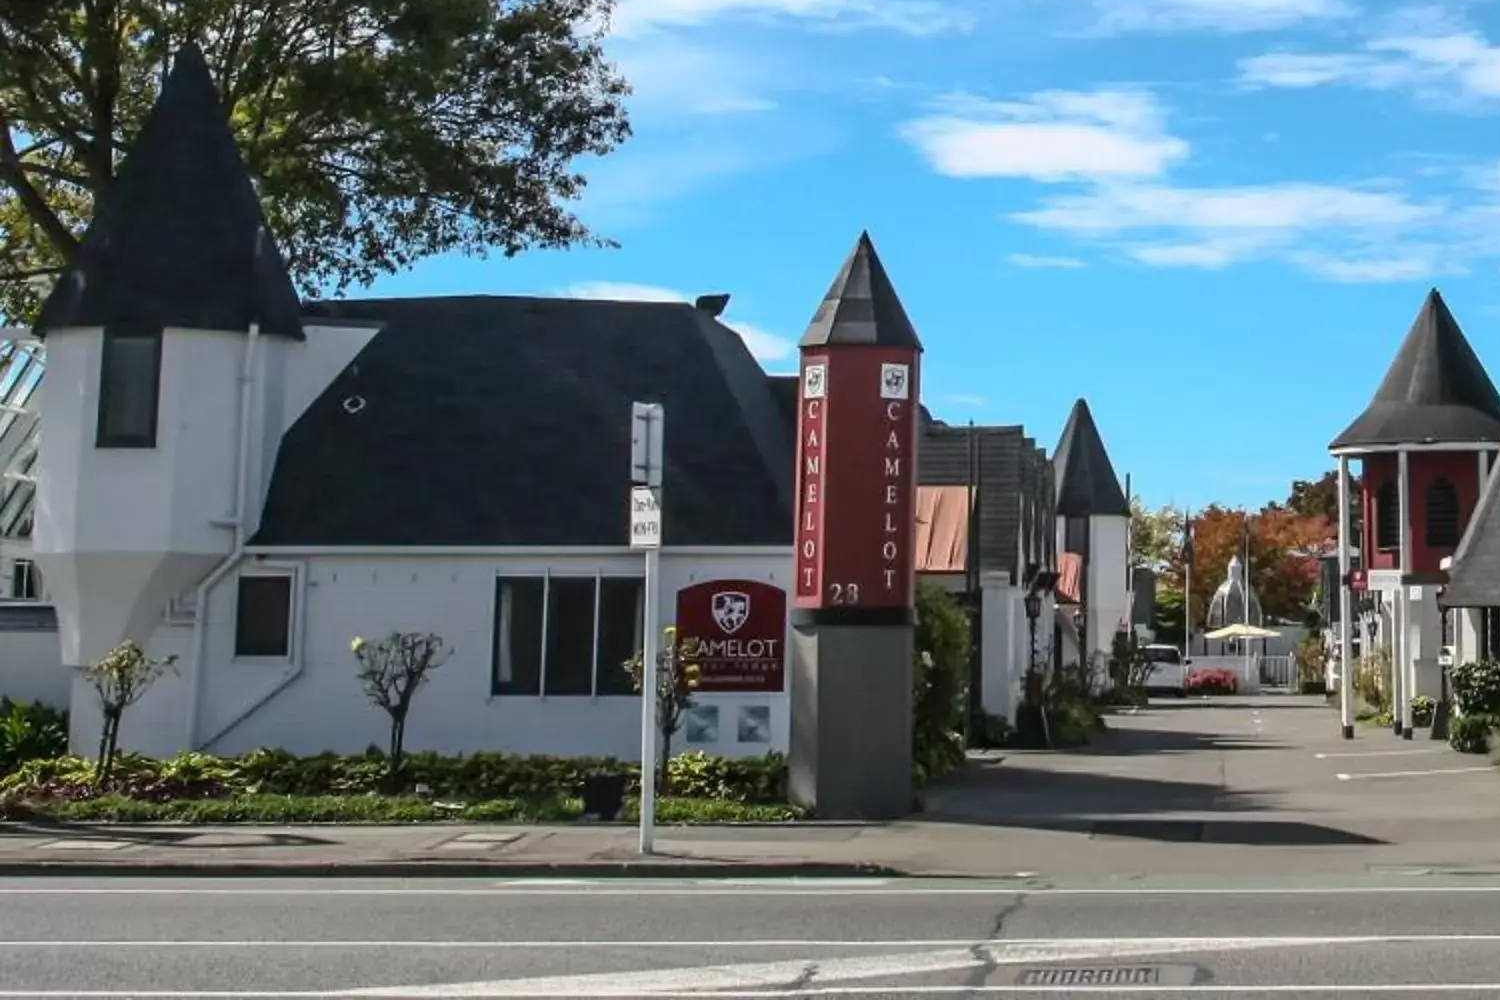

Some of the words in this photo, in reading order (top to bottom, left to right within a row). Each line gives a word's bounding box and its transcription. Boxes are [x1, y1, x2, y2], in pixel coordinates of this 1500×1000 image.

[804, 401, 820, 587] CAMELOT
[883, 402, 900, 589] CAMELOT
[830, 584, 859, 605] 28
